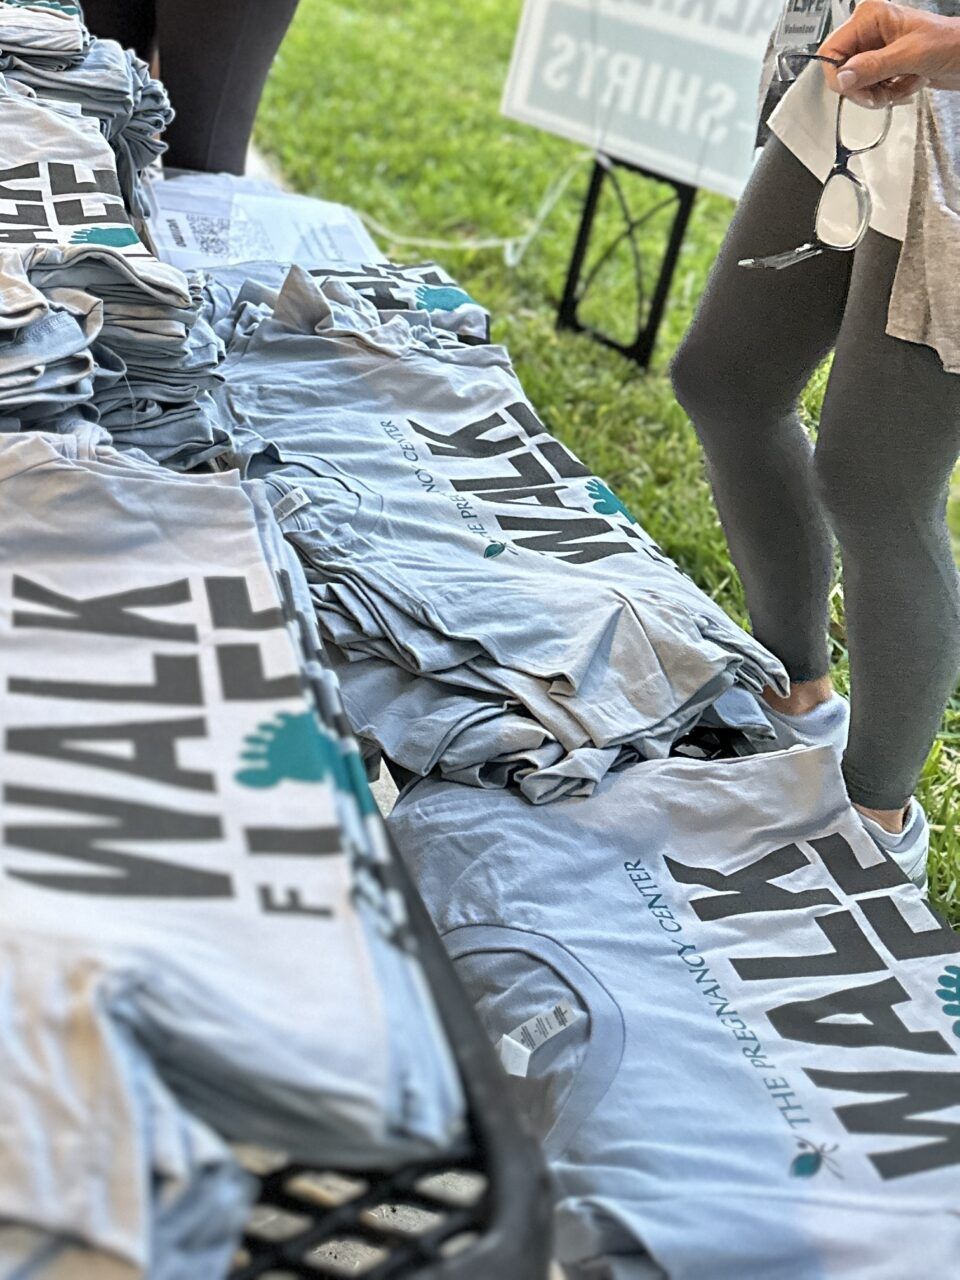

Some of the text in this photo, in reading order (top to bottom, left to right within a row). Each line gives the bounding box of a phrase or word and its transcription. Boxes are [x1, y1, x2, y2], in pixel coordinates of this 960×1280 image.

[407, 412, 638, 564] WALK
[2, 573, 235, 900] WALK
[623, 858, 811, 1130] THE PREGNANCY CENTER
[663, 841, 960, 1181] WALK
